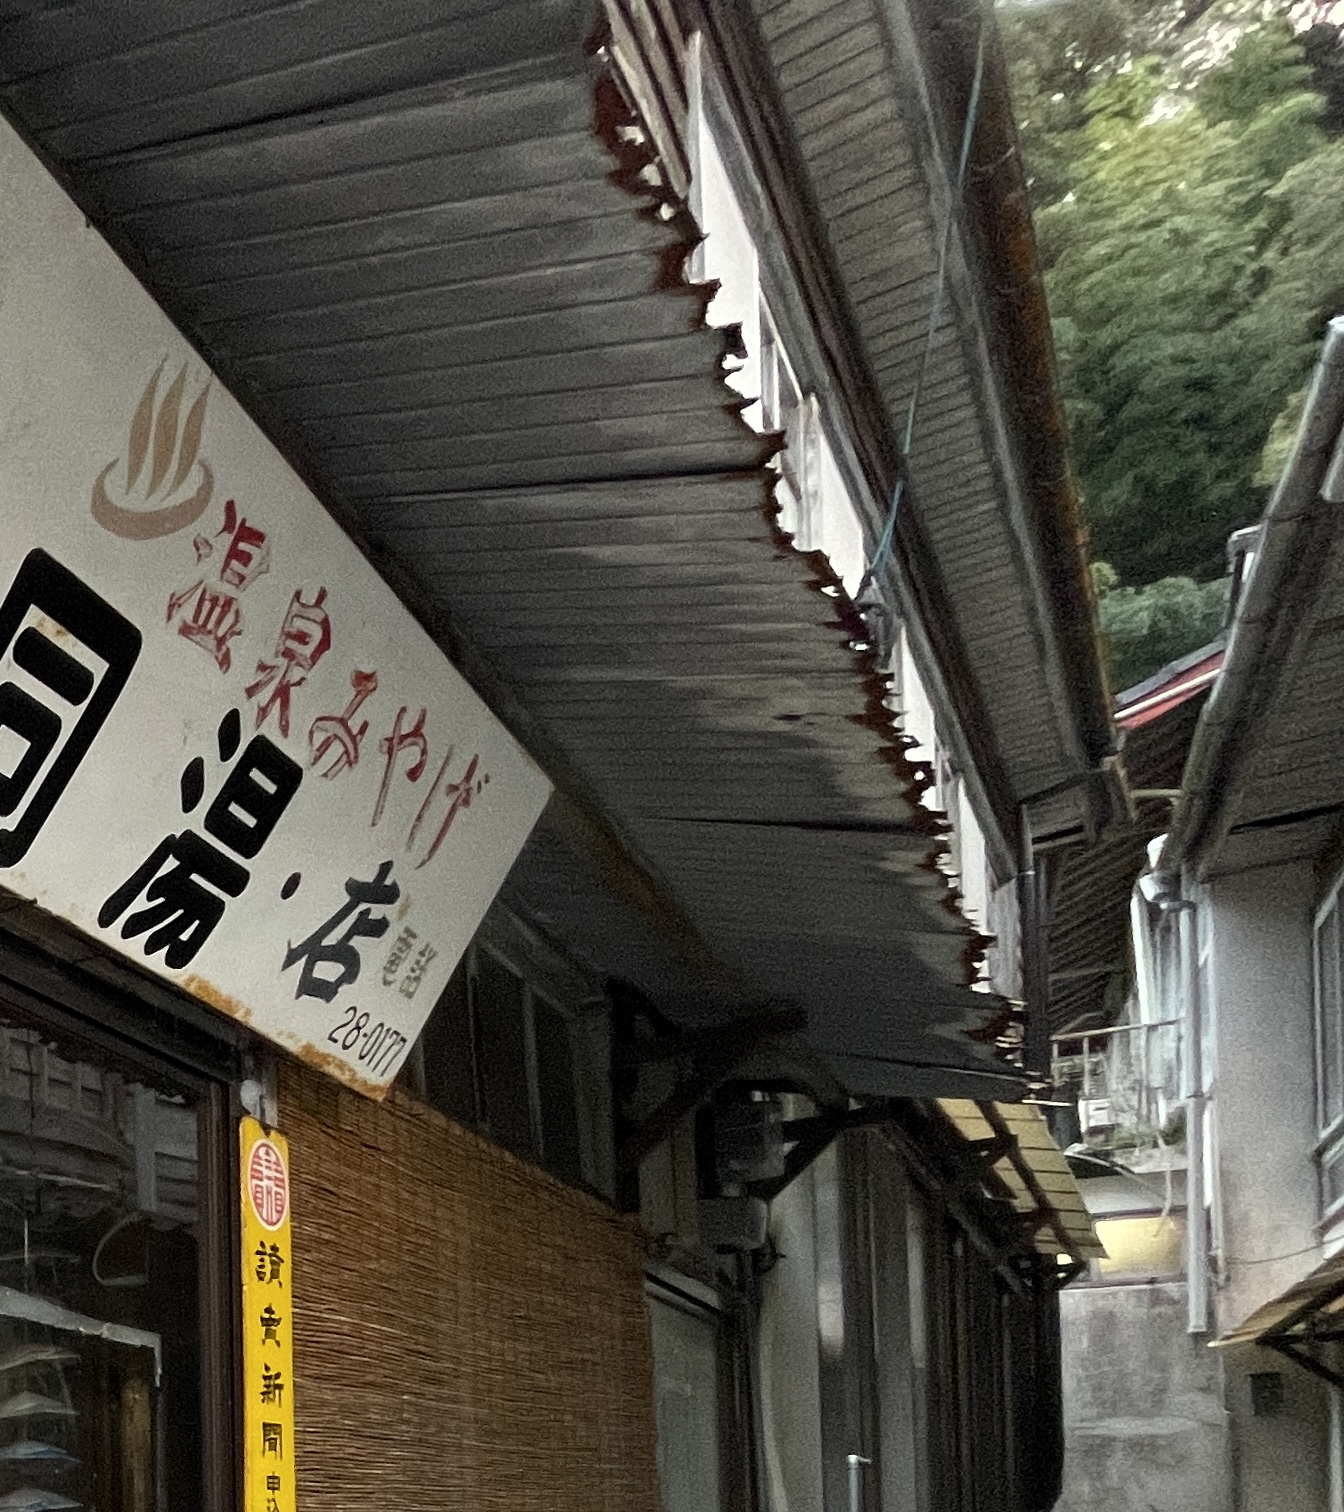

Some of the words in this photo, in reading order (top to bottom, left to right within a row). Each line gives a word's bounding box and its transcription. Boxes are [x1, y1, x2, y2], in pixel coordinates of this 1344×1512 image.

[165, 499, 490, 870] 温泉みやげ
